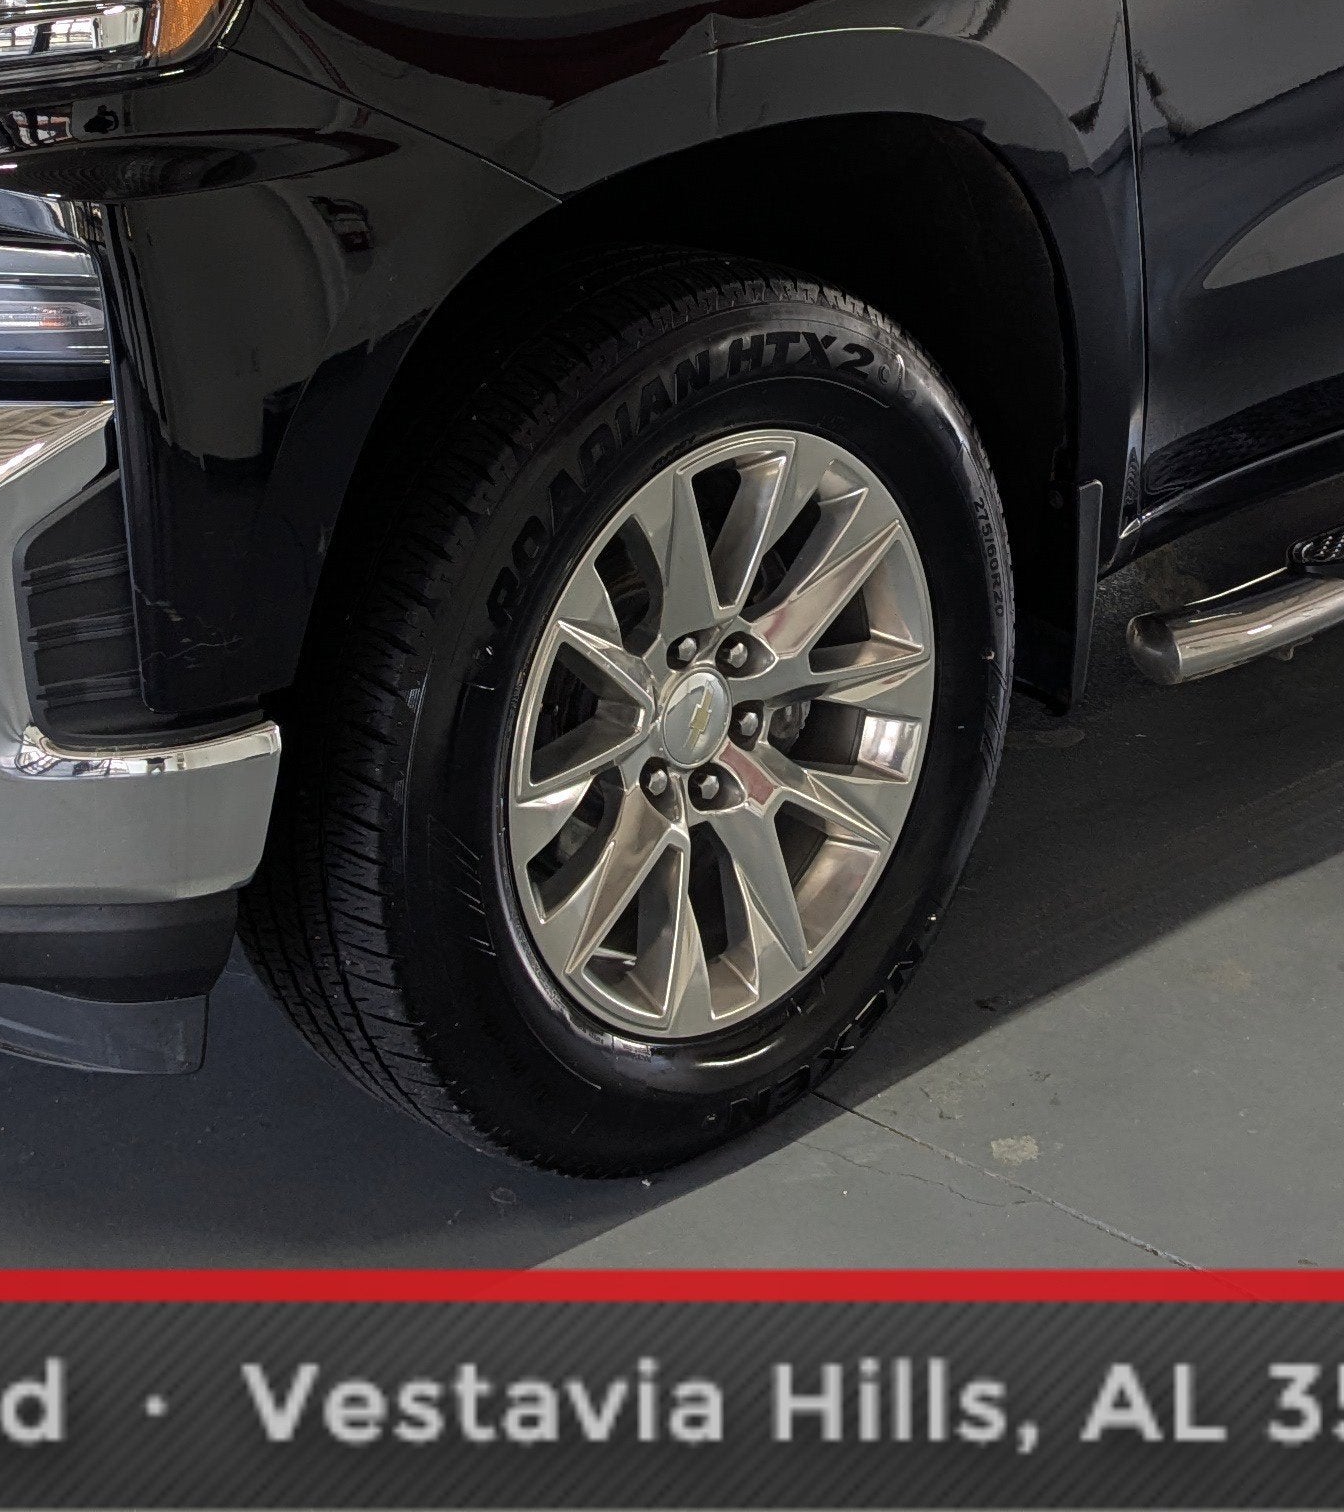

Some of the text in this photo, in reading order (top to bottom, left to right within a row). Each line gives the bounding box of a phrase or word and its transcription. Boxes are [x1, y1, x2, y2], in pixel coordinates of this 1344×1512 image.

[486, 331, 874, 628] ROADIAN HTX2
[973, 496, 1005, 618] 275/60R20
